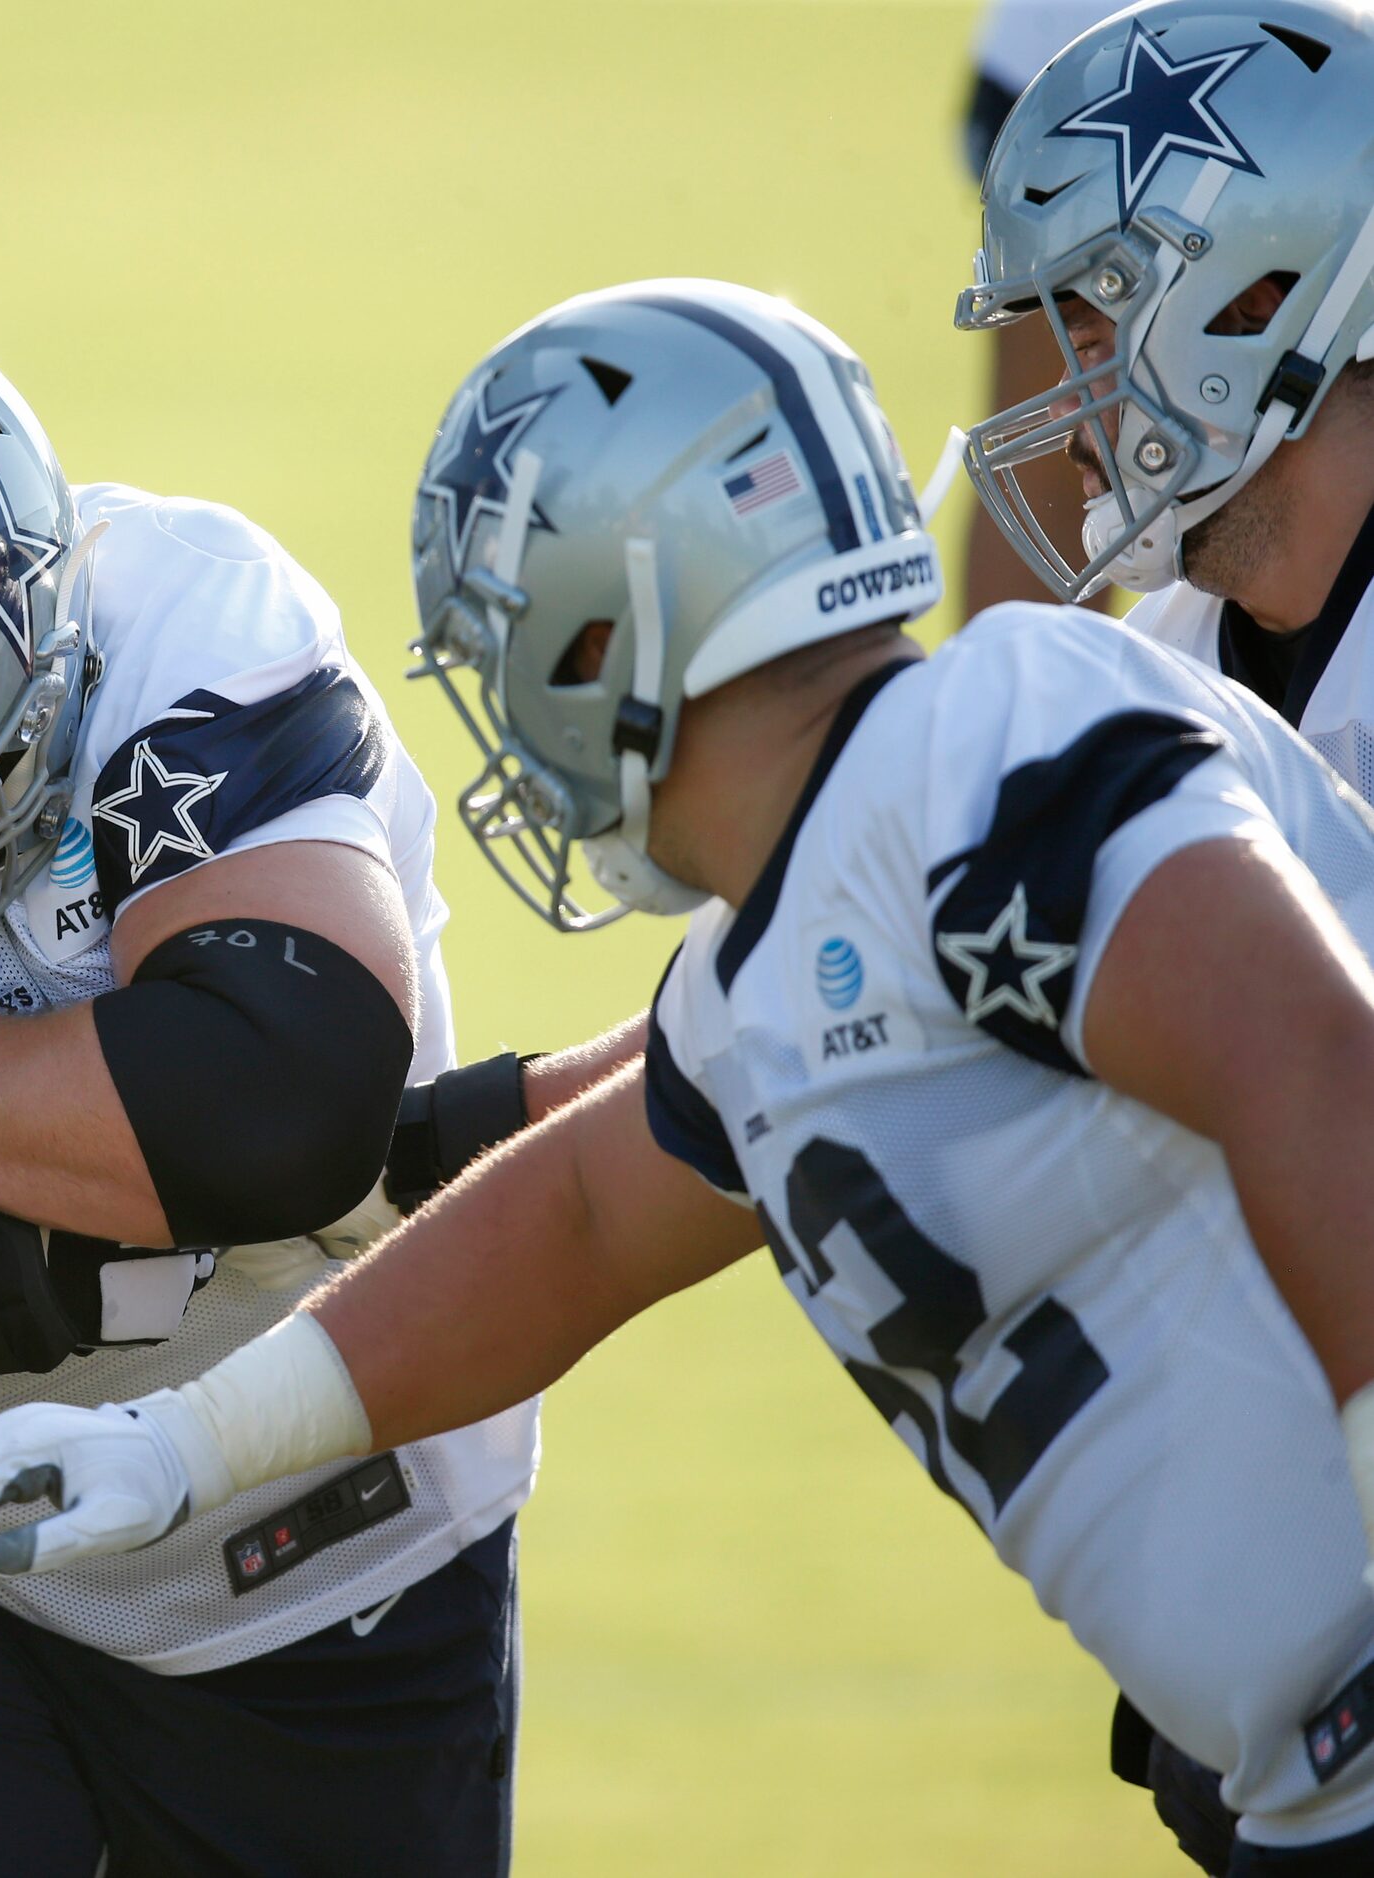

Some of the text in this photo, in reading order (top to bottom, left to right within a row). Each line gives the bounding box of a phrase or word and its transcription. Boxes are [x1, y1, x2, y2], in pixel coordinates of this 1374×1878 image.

[56, 891, 104, 941] AT&
[283, 935, 318, 977] L
[823, 1011, 889, 1061] AT&T
[756, 1136, 1110, 1545] 2
